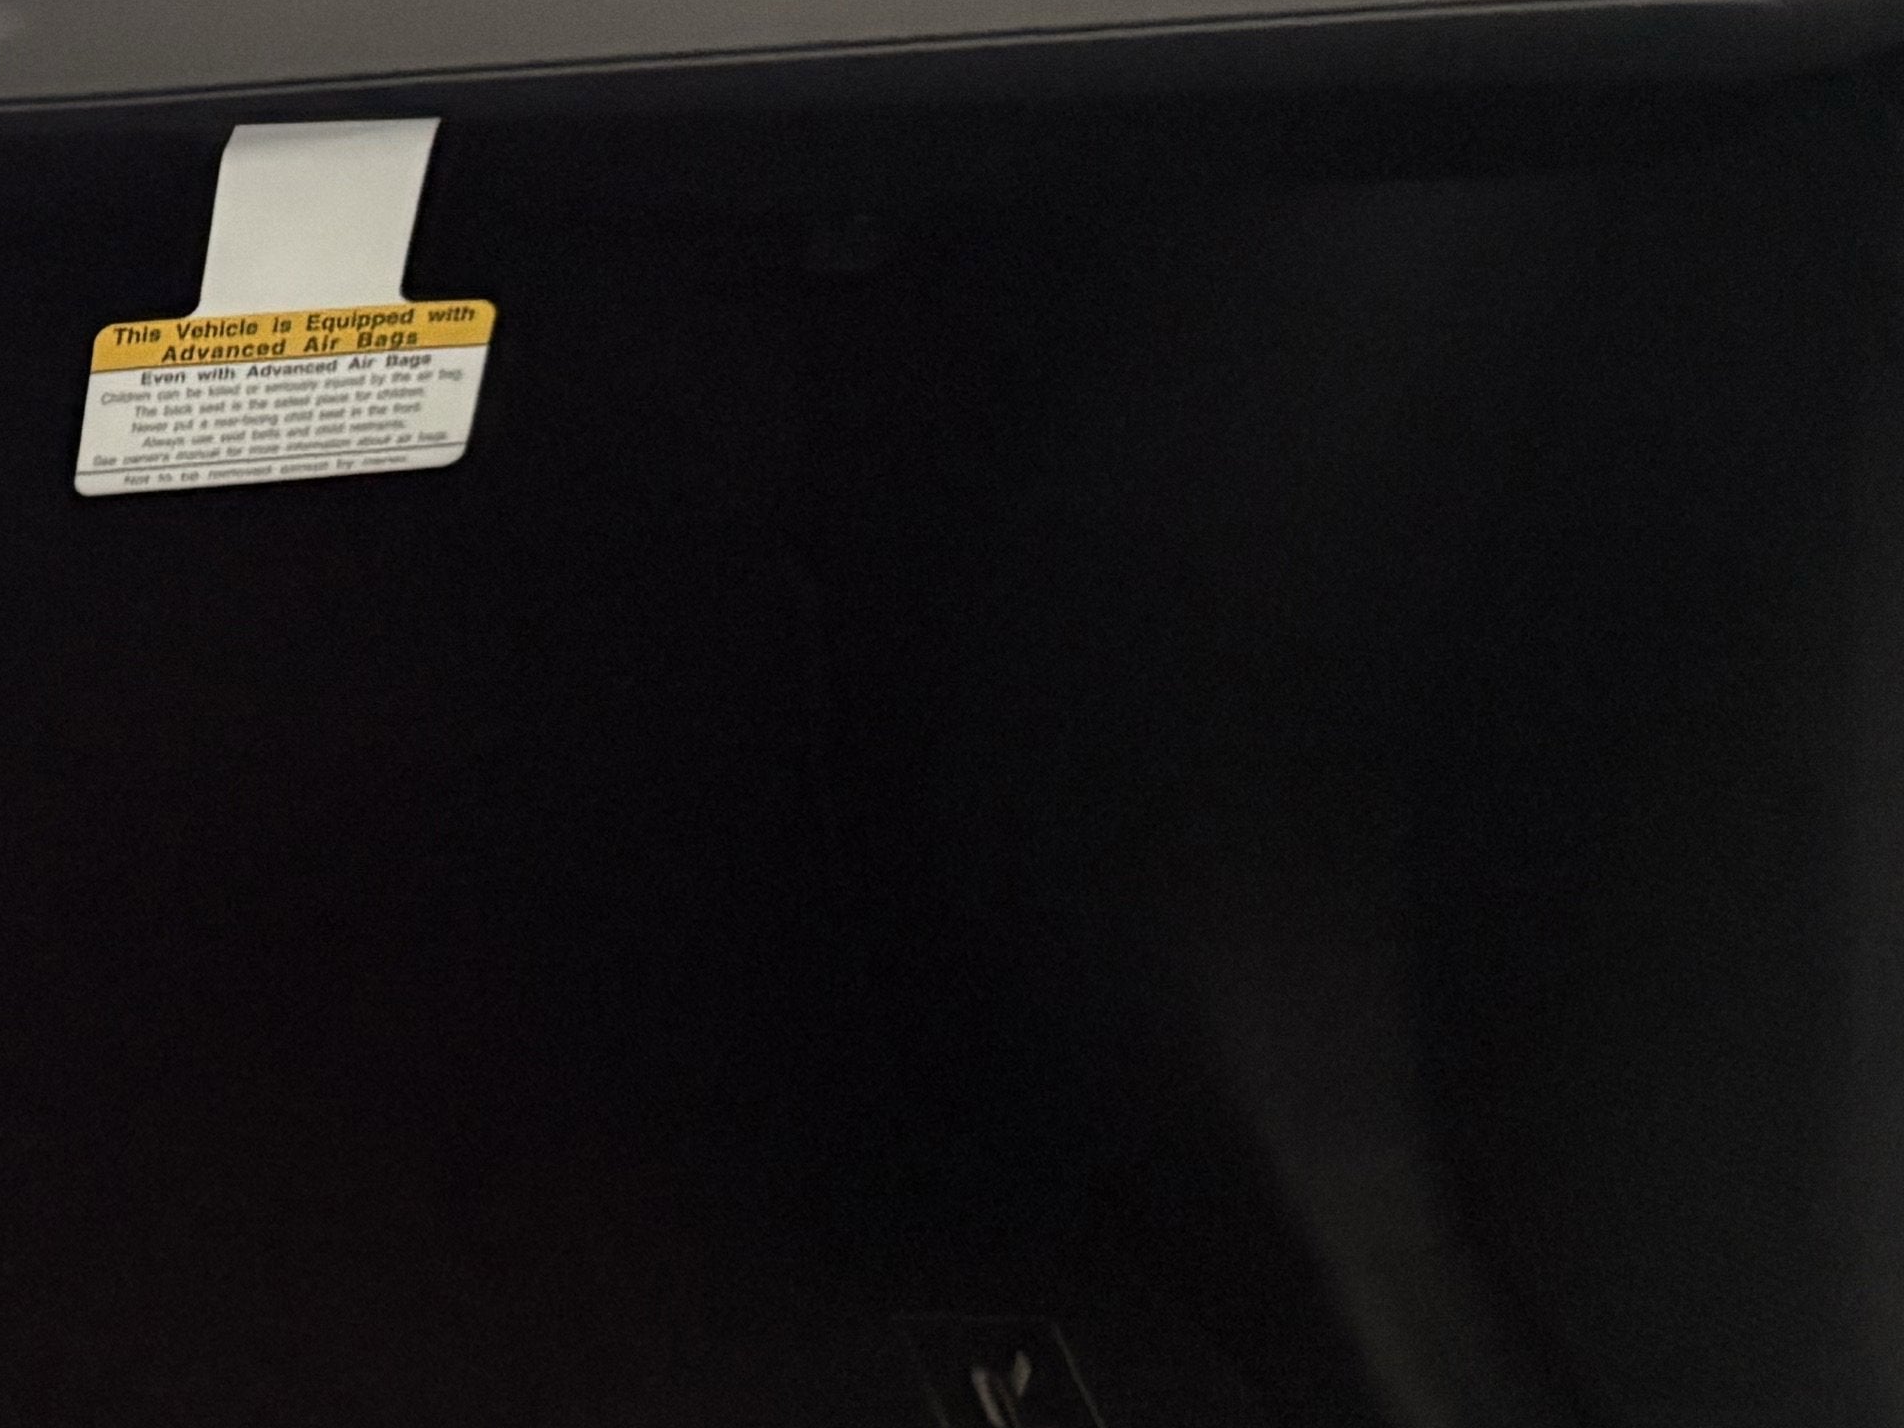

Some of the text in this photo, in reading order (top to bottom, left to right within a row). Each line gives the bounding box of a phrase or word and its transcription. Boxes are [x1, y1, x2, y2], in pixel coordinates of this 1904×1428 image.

[114, 306, 475, 346] This Vehicle is Equipped with
[162, 331, 418, 363] Advanced Air Bags
[141, 353, 432, 386] Even with Advanced Air Bags
